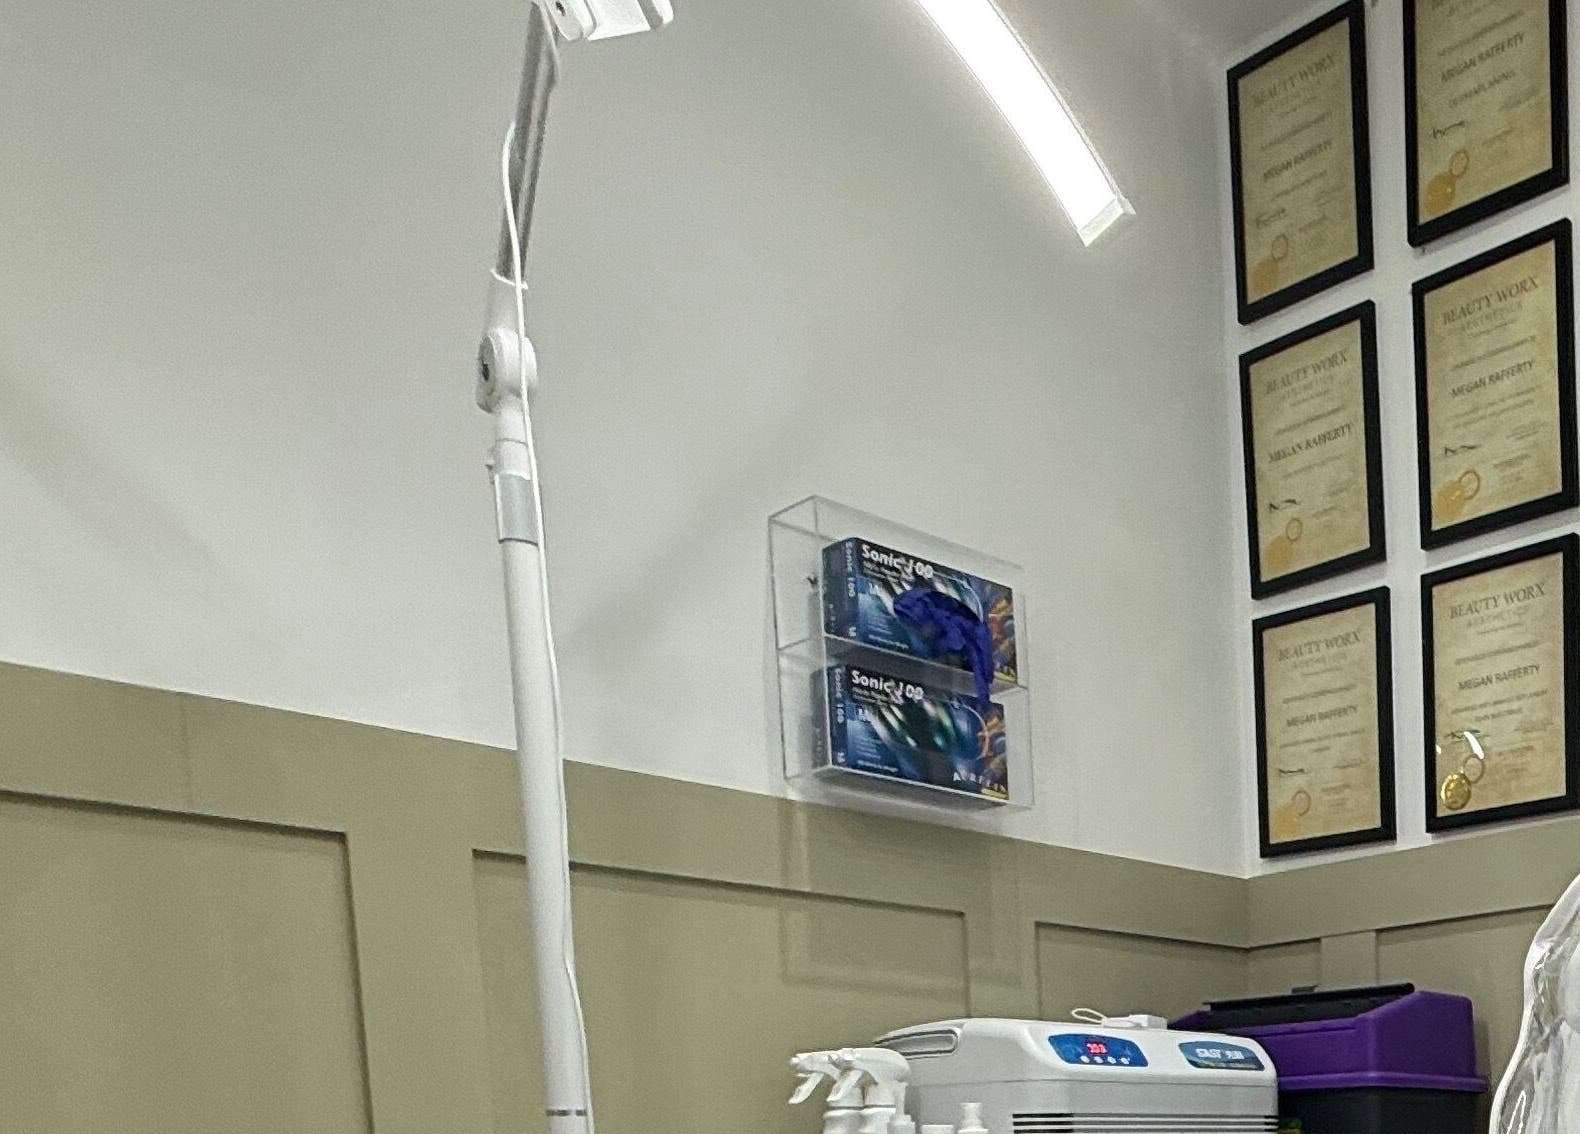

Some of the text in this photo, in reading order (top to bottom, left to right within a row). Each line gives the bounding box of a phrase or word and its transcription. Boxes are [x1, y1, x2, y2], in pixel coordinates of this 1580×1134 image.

[1442, 274, 1539, 326] BEAUTY WORX
[1450, 359, 1535, 399] MEGAN RAFFERTY
[1304, 421, 1353, 450] RAFFERTY
[861, 543, 904, 571] Sonic
[1449, 580, 1547, 619] BEAUTY WORX
[851, 669, 895, 694] Sonic
[1458, 663, 1541, 691] MEGAN RAFFERTY
[1286, 704, 1359, 728] MEGAN RAFFERTY
